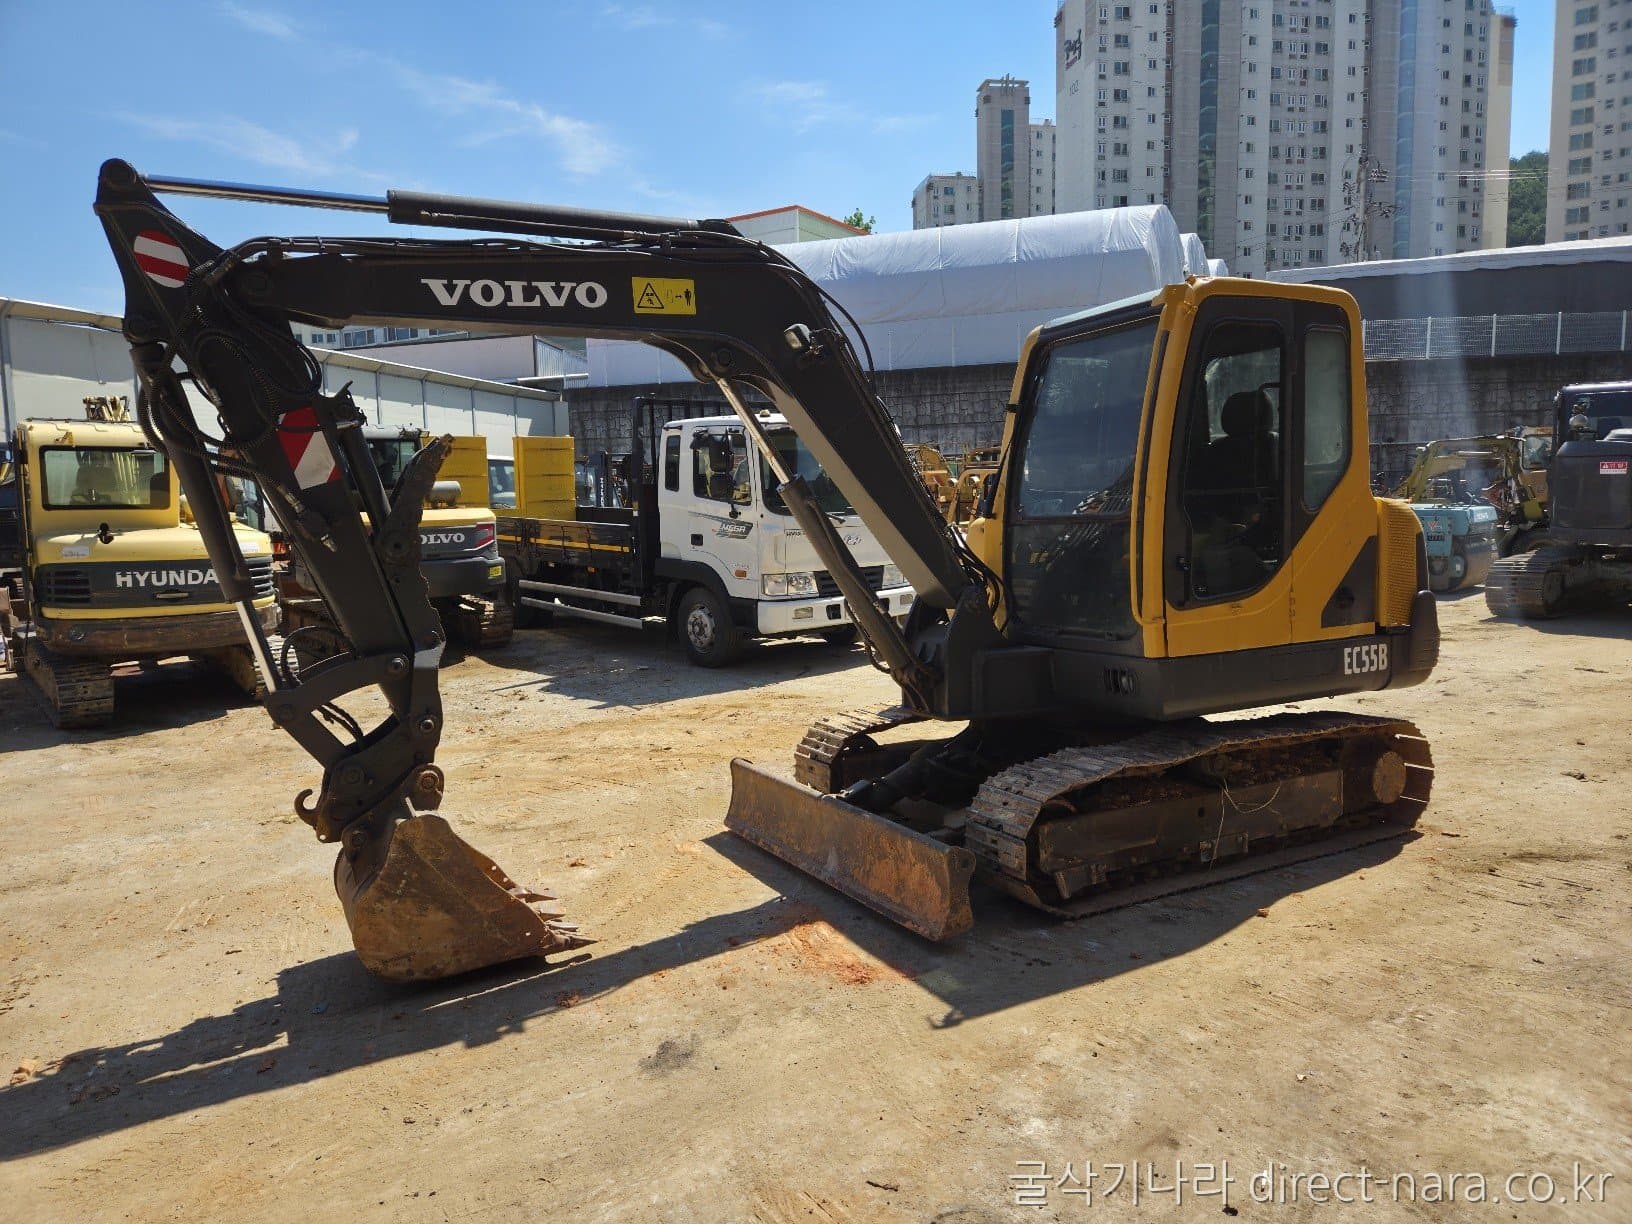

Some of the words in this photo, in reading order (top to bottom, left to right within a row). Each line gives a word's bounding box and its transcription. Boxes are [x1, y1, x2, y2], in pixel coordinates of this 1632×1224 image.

[420, 278, 608, 309] VOLVO
[419, 532, 466, 545] OLVO
[115, 568, 220, 588] HYUNDA
[1343, 643, 1388, 675] EC55B
